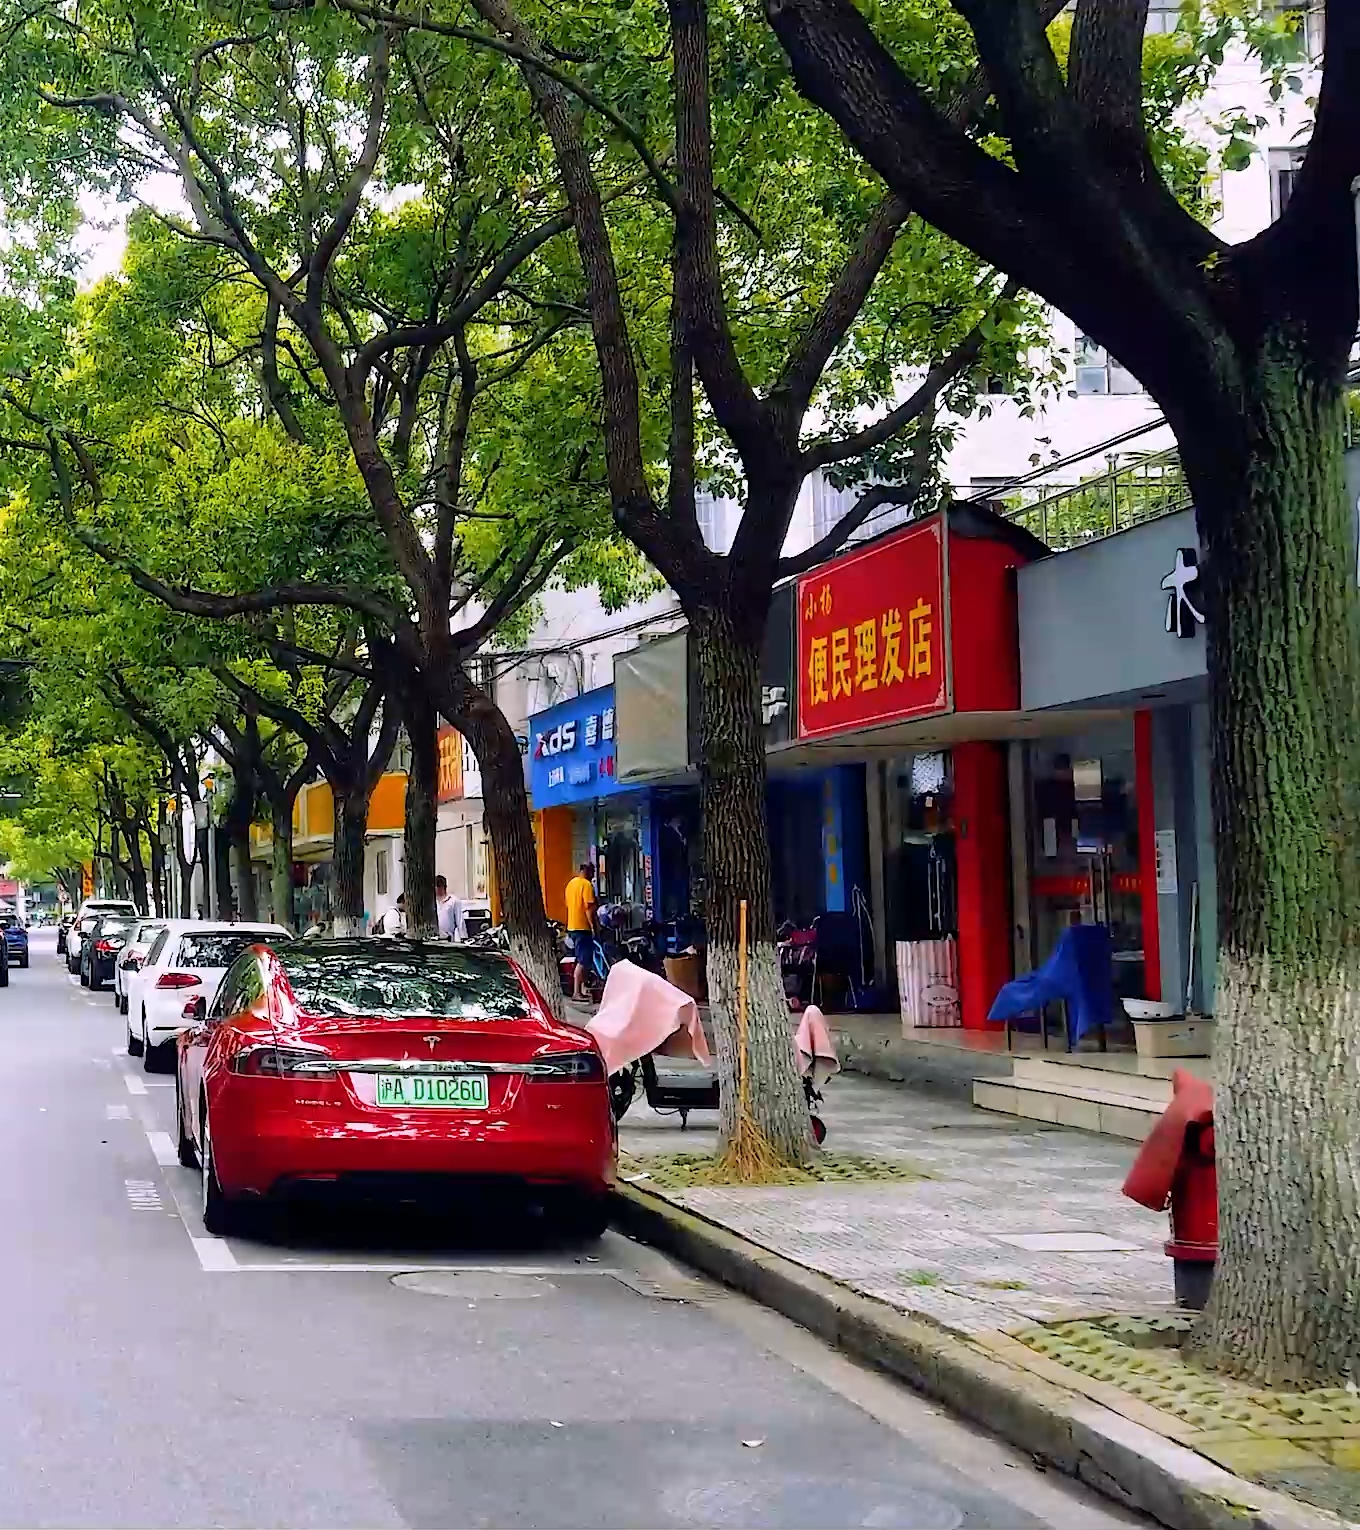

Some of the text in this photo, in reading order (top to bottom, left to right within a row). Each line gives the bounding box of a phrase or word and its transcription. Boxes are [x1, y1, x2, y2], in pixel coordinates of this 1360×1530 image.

[808, 598, 933, 706] 便民理发店
[414, 1079, 482, 1101] D10260
